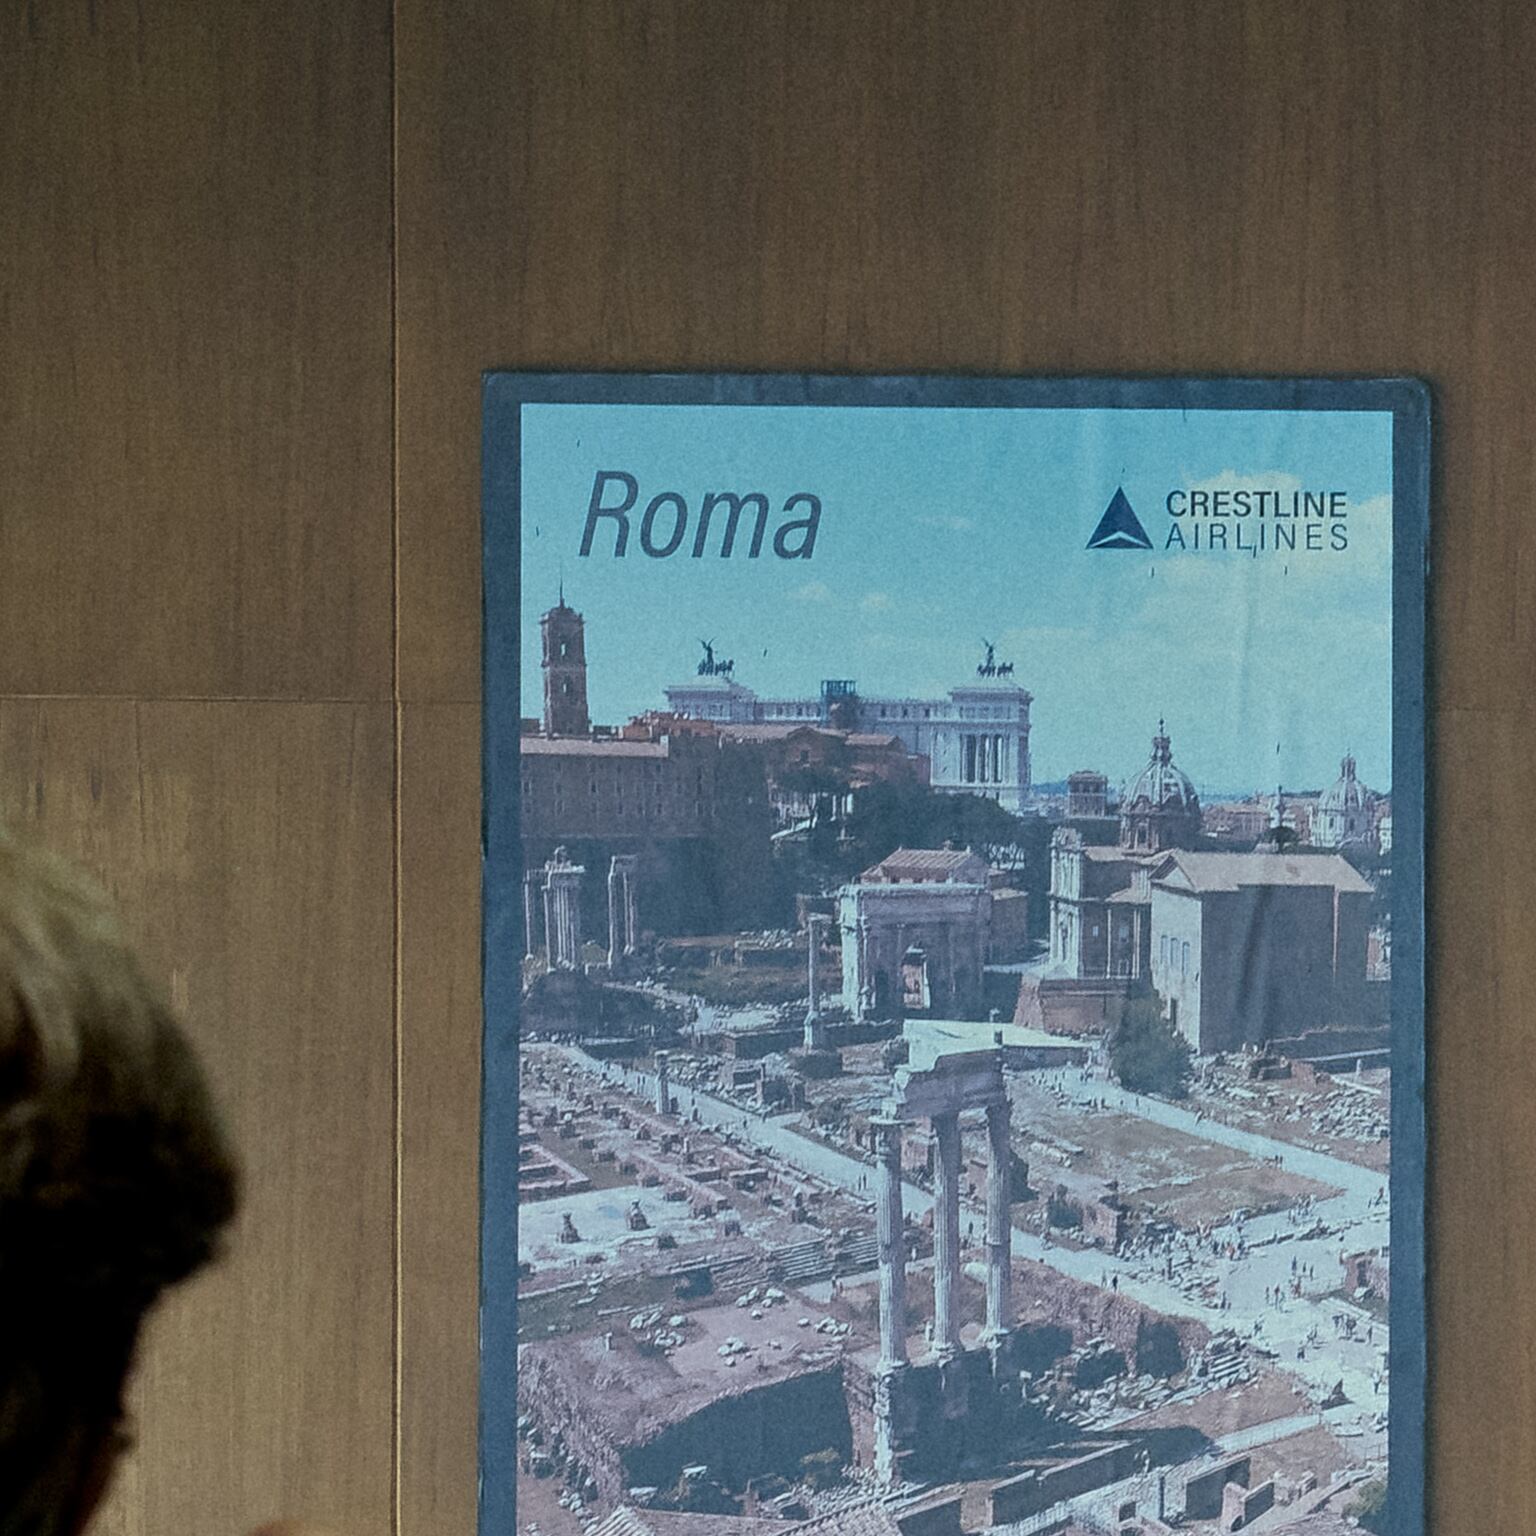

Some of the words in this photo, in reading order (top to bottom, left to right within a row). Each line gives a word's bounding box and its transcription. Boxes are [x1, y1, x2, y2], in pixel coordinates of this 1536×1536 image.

[578, 470, 823, 560] Roma
[1165, 489, 1349, 518] CRESTLINE
[1164, 522, 1349, 551] AIRLINES
